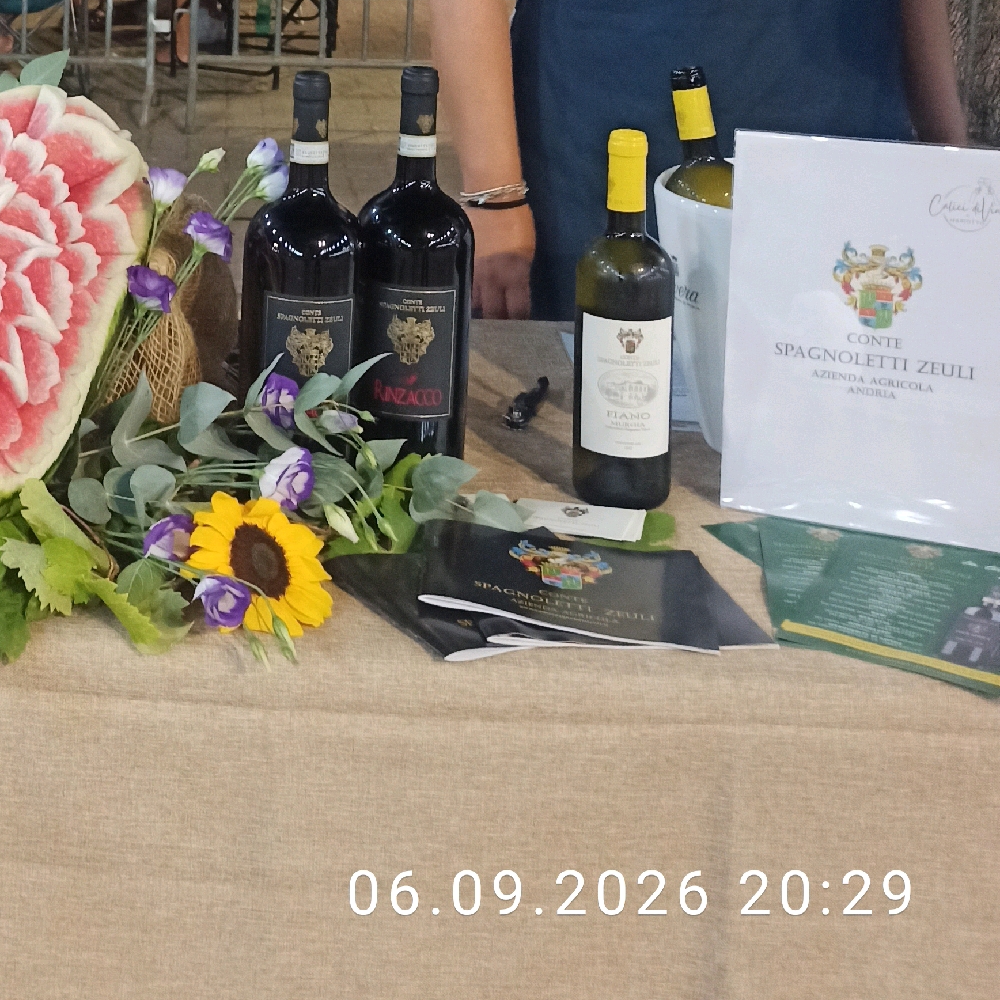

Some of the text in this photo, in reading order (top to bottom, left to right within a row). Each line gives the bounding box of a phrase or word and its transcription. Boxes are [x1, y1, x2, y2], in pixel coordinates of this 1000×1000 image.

[847, 332, 902, 349] CONTE
[774, 342, 975, 380] SPAGNOLETTI ZEULI
[811, 369, 934, 393] AZIENDA AGRICOLA
[847, 386, 896, 400] ANDRIA
[606, 409, 651, 421] FIANO
[474, 580, 592, 613] SPAGNOLETTI
[604, 608, 655, 622] ZEULI
[539, 588, 589, 604] CONTE
